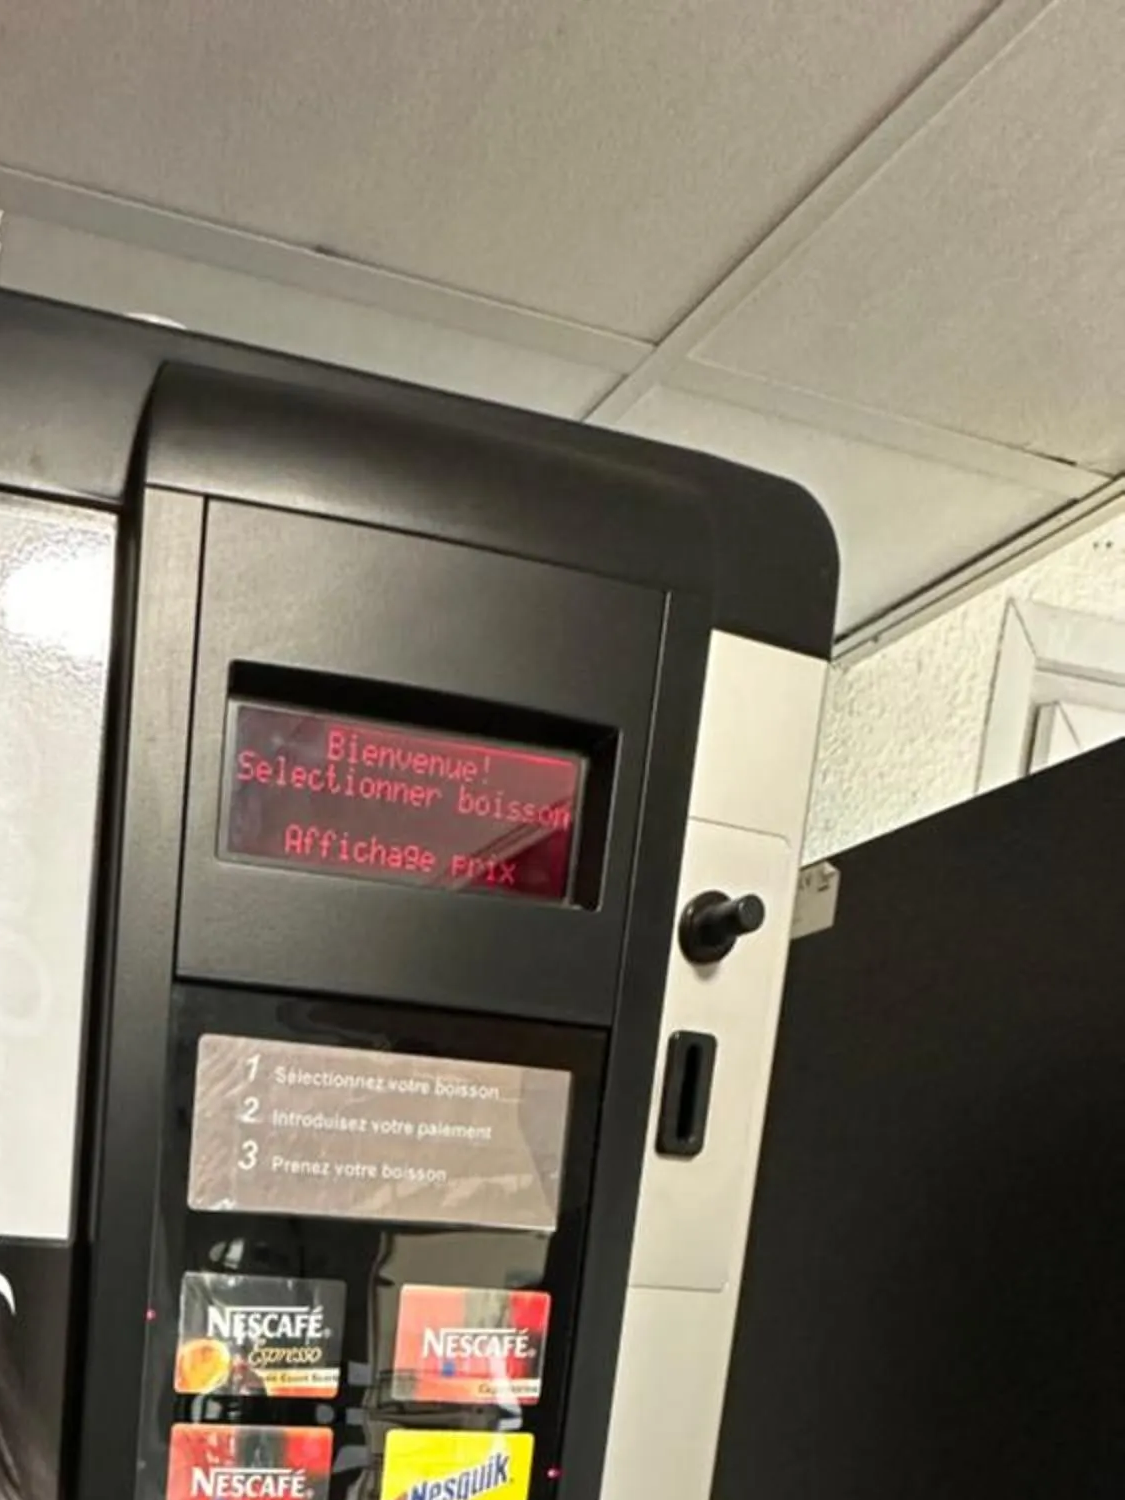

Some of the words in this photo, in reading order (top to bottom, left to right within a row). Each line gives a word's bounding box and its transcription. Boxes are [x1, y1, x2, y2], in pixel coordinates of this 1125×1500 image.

[327, 730, 490, 785] Bienvenue!
[237, 751, 442, 808] Selectionner
[458, 786, 571, 830] boisson
[284, 824, 437, 874] Affichage
[245, 1054, 261, 1082] 1
[387, 1077, 430, 1095] votre
[434, 1077, 500, 1100] boisson
[240, 1096, 259, 1124] 2
[273, 1109, 367, 1132] Introduisez
[371, 1117, 414, 1137] votre
[417, 1121, 493, 1142] paiement
[237, 1139, 259, 1171] 3
[271, 1155, 331, 1177] Prenez
[335, 1161, 377, 1179] votre
[381, 1162, 447, 1183] boisson
[422, 1326, 530, 1360] NESCAFÉ
[190, 1466, 307, 1499] NESCAFÉ
